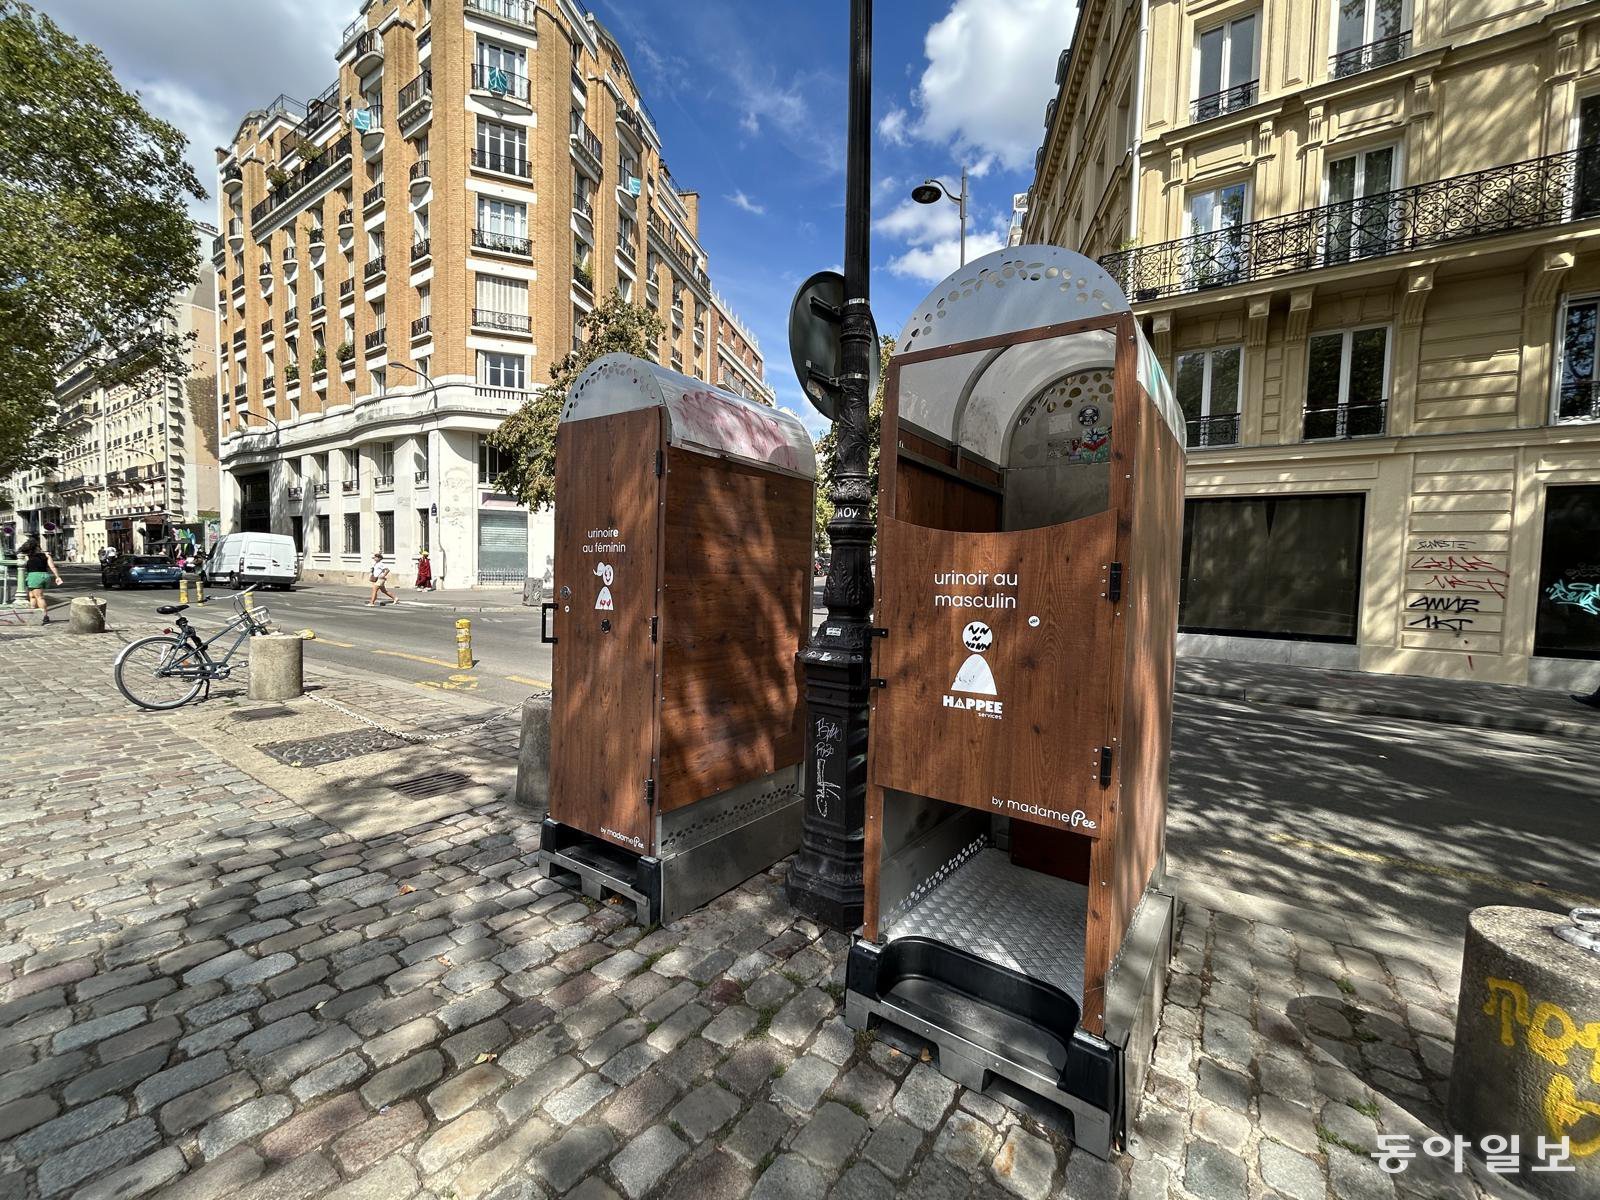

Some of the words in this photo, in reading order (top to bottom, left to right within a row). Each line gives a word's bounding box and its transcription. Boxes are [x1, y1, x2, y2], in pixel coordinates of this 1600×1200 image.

[587, 527, 619, 538] urinoire
[582, 544, 593, 553] au
[595, 542, 626, 553] féminin
[934, 570, 989, 586] urinoir
[993, 572, 1018, 586] au
[935, 593, 1016, 609] masculin
[942, 695, 1003, 714] HAPPEE
[991, 796, 1004, 808] by
[600, 827, 607, 835] by
